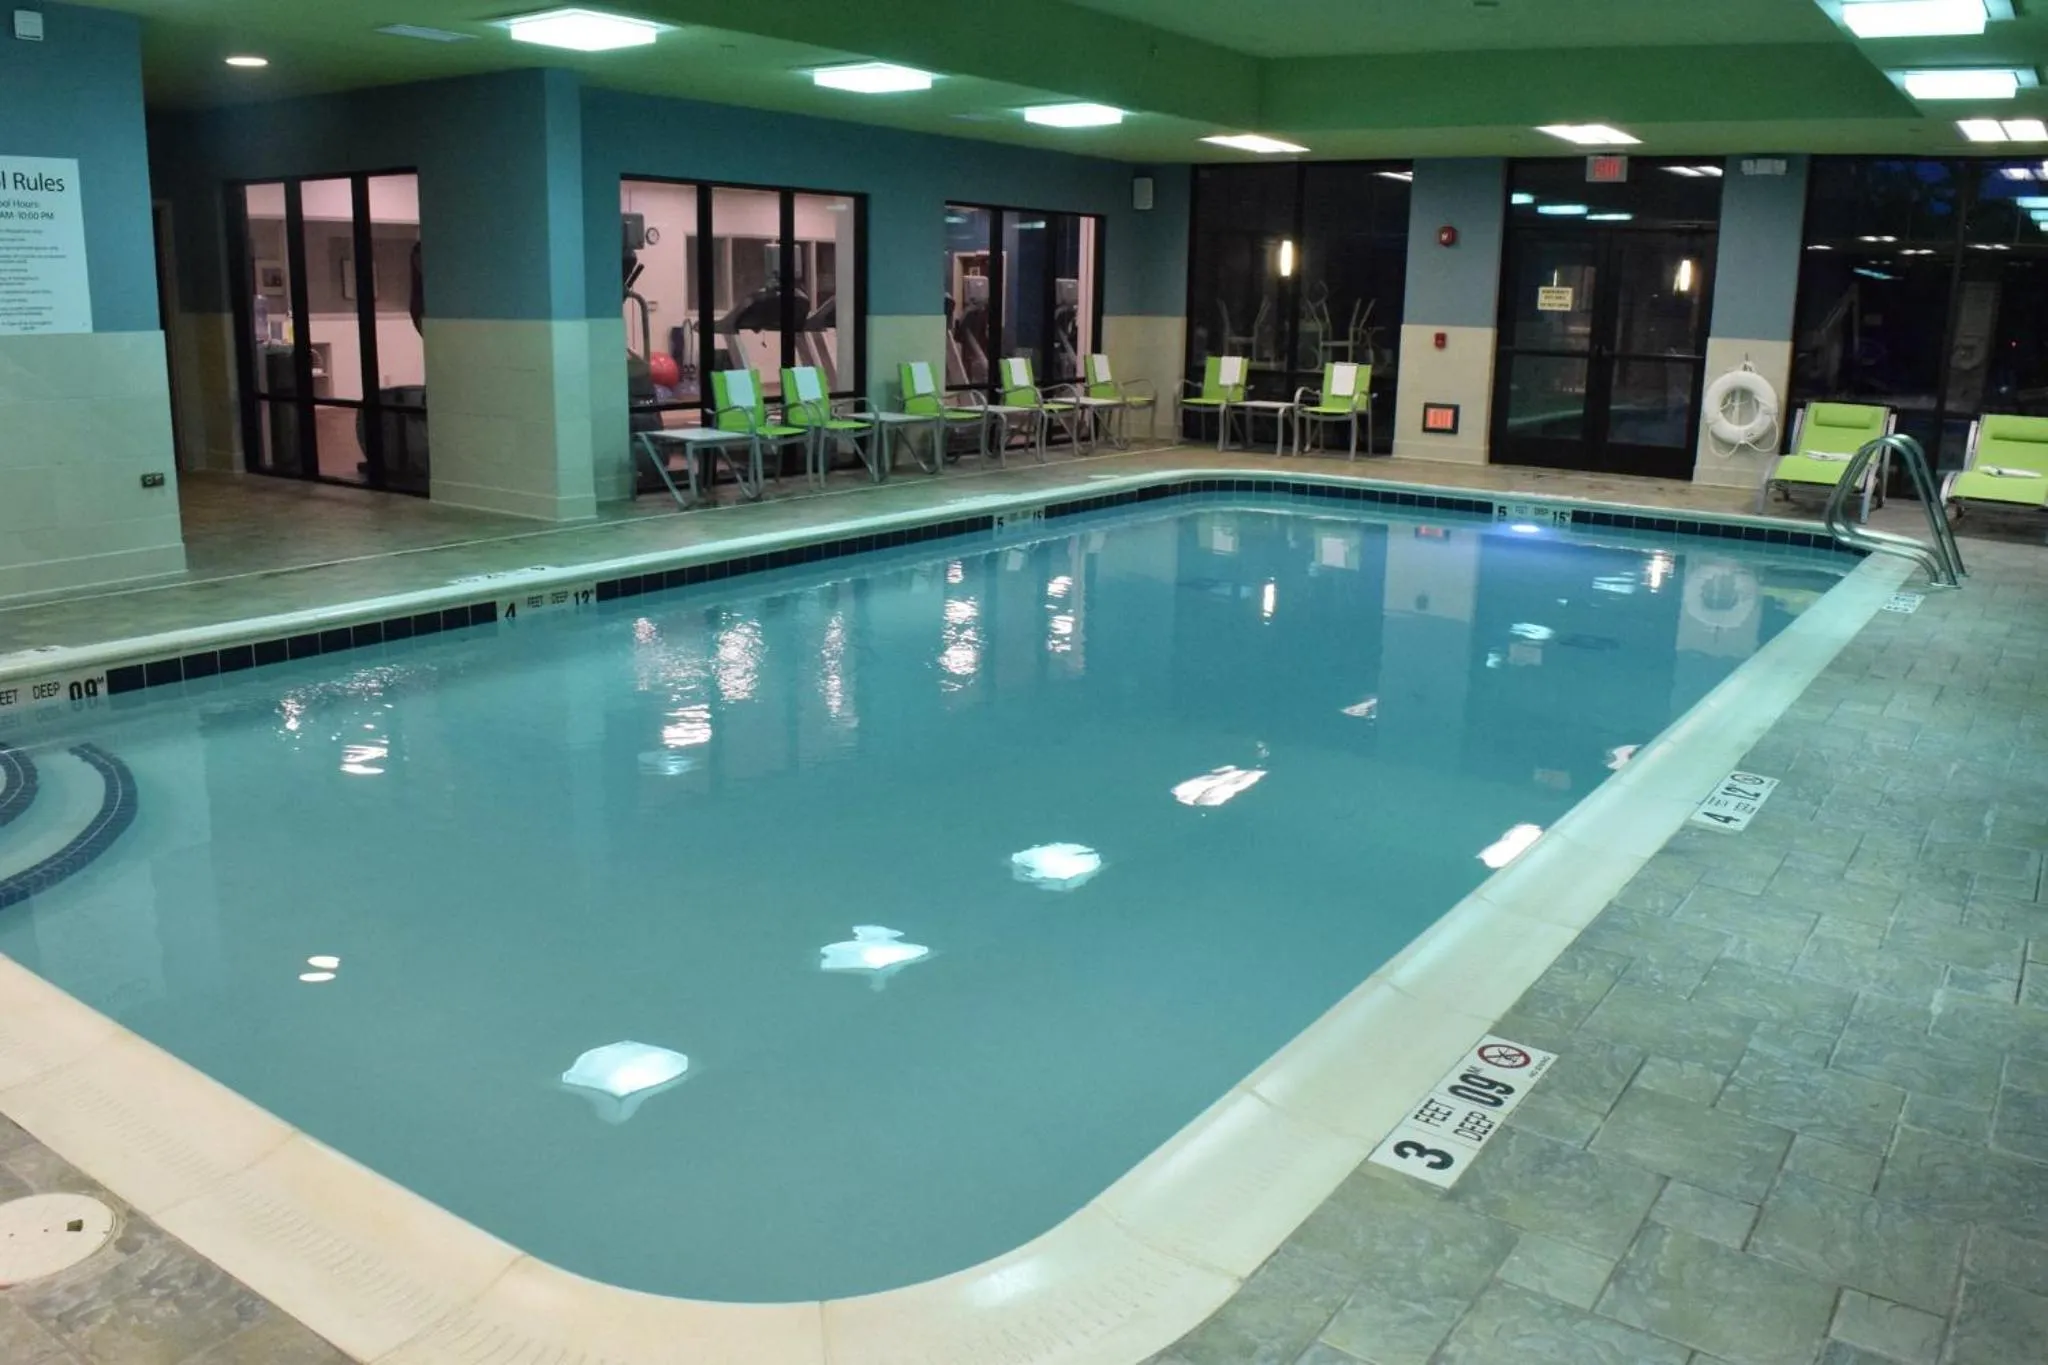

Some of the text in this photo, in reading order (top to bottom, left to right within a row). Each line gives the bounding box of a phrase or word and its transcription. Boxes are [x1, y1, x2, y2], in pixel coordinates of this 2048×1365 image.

[13, 171, 65, 192] Rules
[0, 688, 18, 706] EET
[32, 681, 61, 700] DEEP
[1702, 811, 1741, 824] 4
[1413, 1098, 1456, 1127] FEET
[1452, 1110, 1495, 1142] DEEP
[1393, 1140, 1454, 1170] 3
